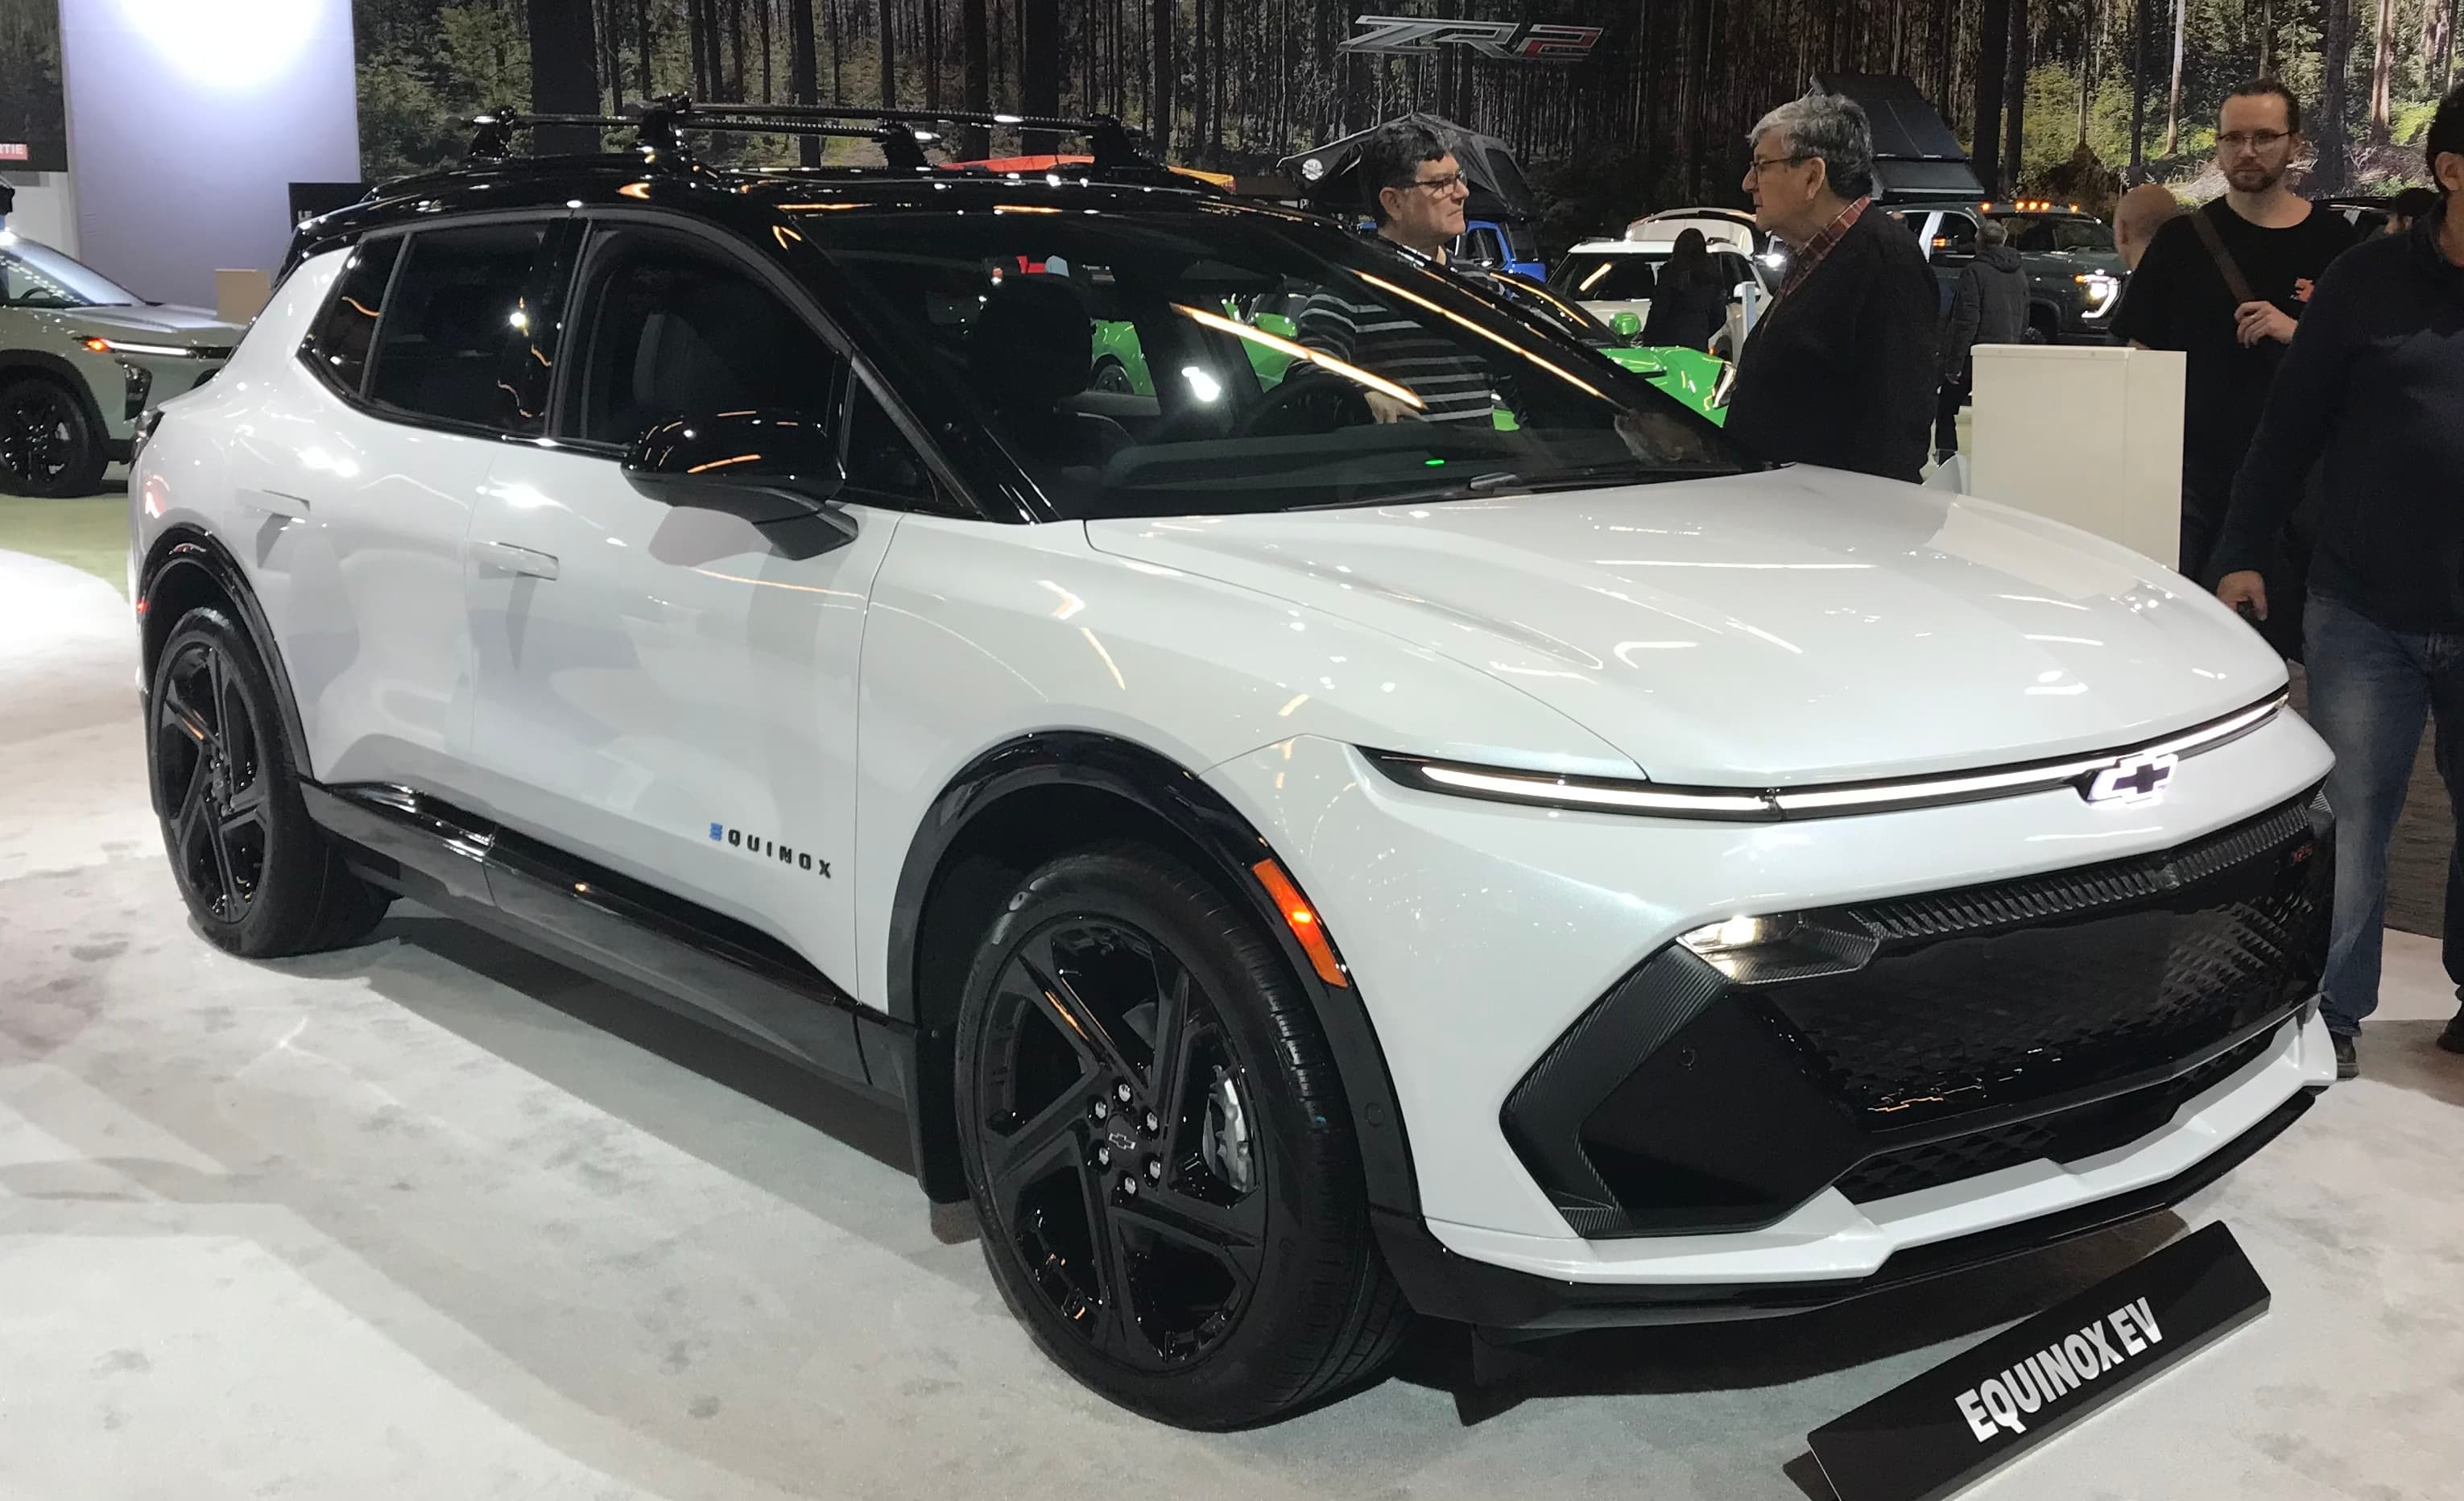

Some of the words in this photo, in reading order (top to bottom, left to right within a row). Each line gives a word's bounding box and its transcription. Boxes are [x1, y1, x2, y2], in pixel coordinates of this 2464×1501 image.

[1335, 15, 1603, 61] ZR2
[709, 822, 831, 879] EQUINOX
[1955, 1321, 2124, 1442] EQUINOX
[2107, 1297, 2163, 1356] EV
